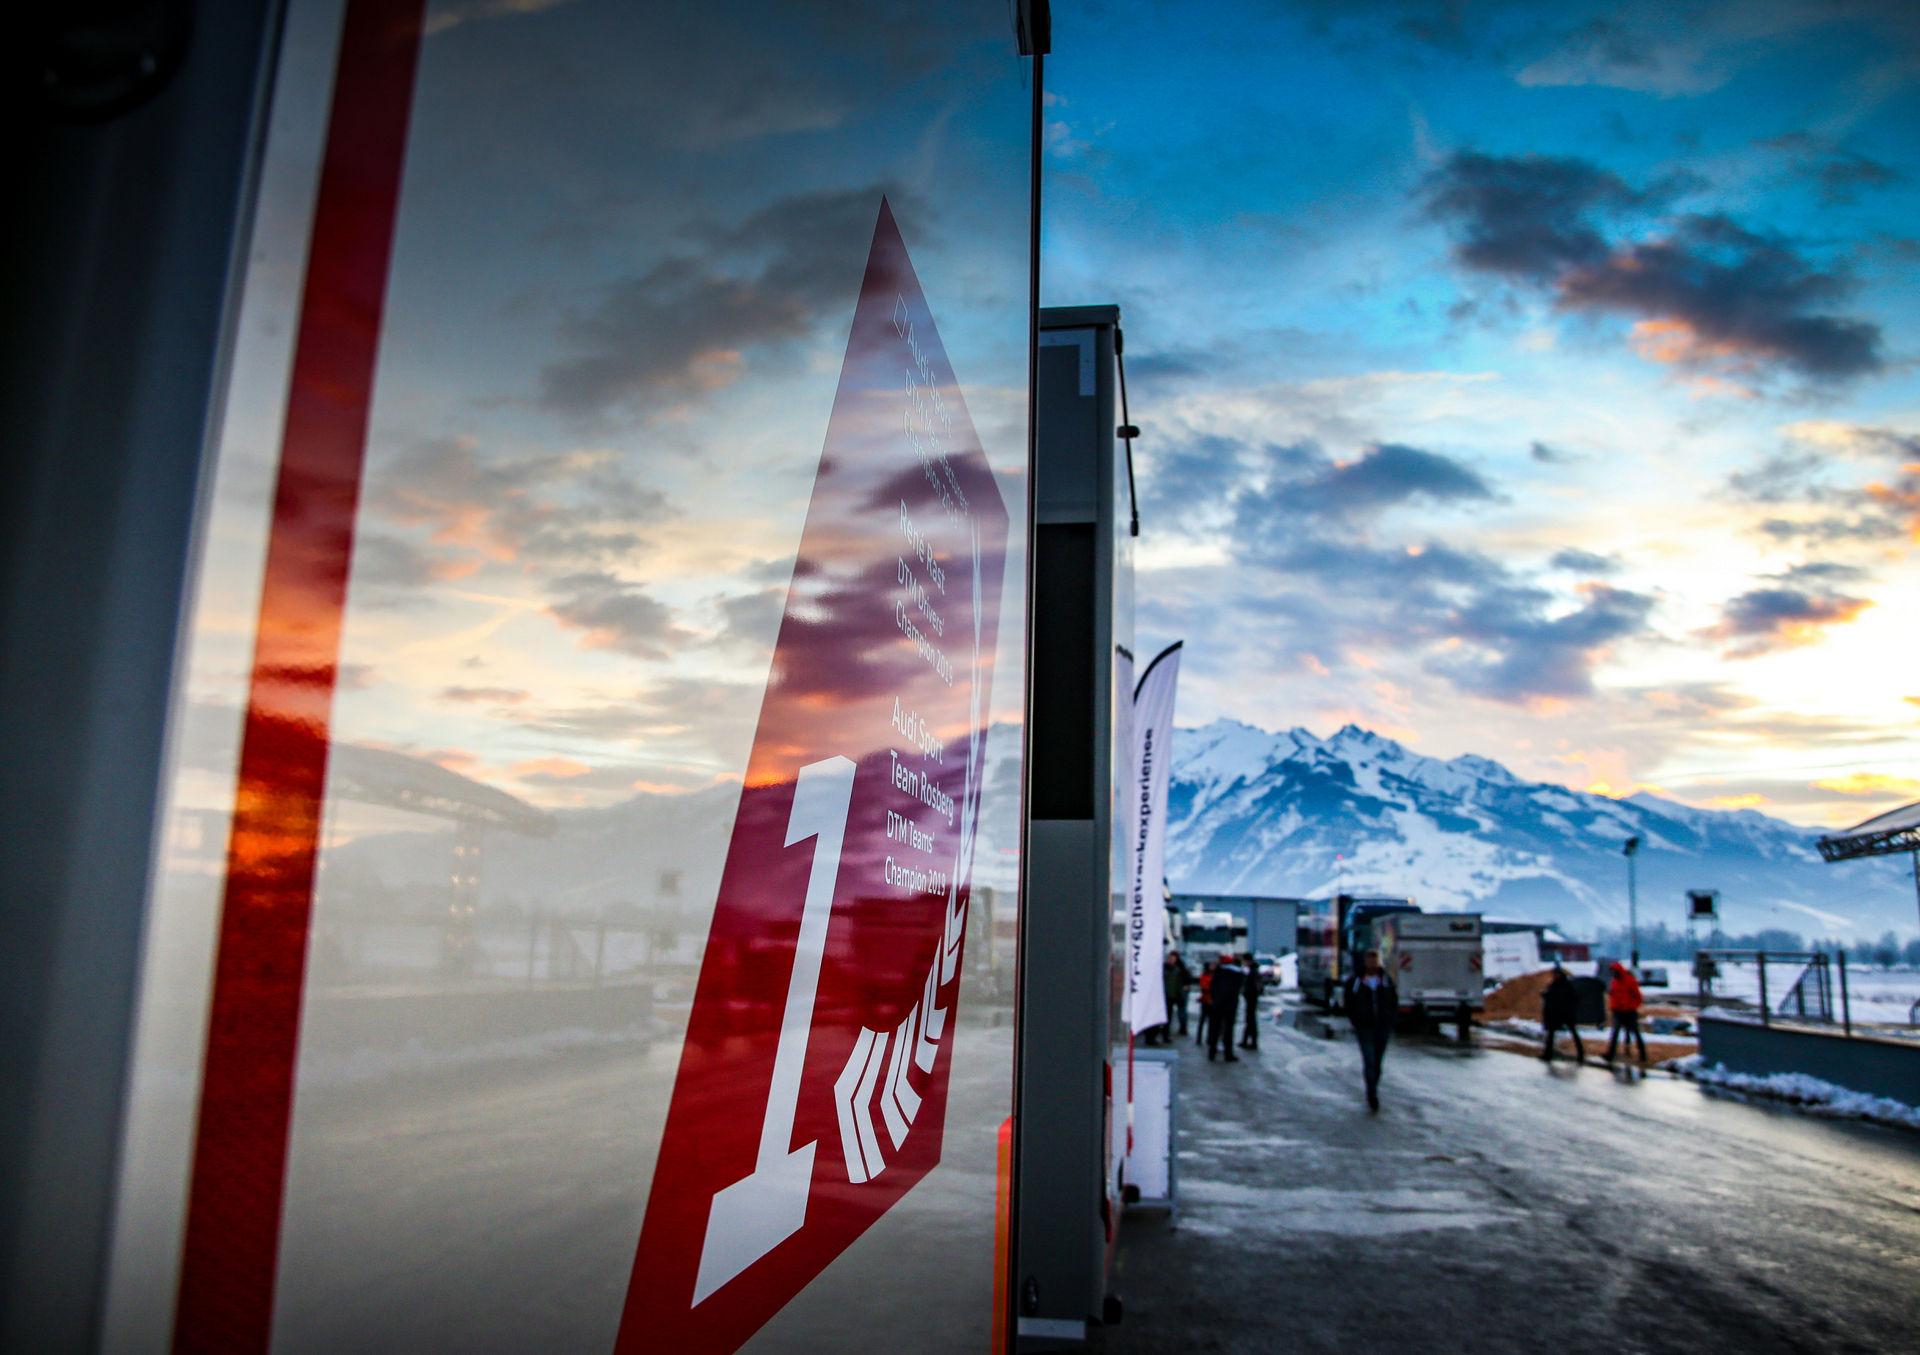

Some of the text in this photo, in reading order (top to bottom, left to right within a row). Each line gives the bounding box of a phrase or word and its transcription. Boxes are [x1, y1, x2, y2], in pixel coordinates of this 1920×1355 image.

[905, 368, 924, 424] DTM
[907, 322, 952, 440] Audi Sport
[903, 410, 941, 499] Champion
[897, 556, 917, 603] DTM
[900, 498, 946, 596] René Rast
[895, 600, 936, 665] Champion
[891, 695, 944, 766] Audi Sport
[890, 749, 954, 826] Team Rosberg
[886, 809, 935, 854] DTM Teams'
[884, 855, 946, 897] Champion 2019
[690, 754, 857, 1310] 1
